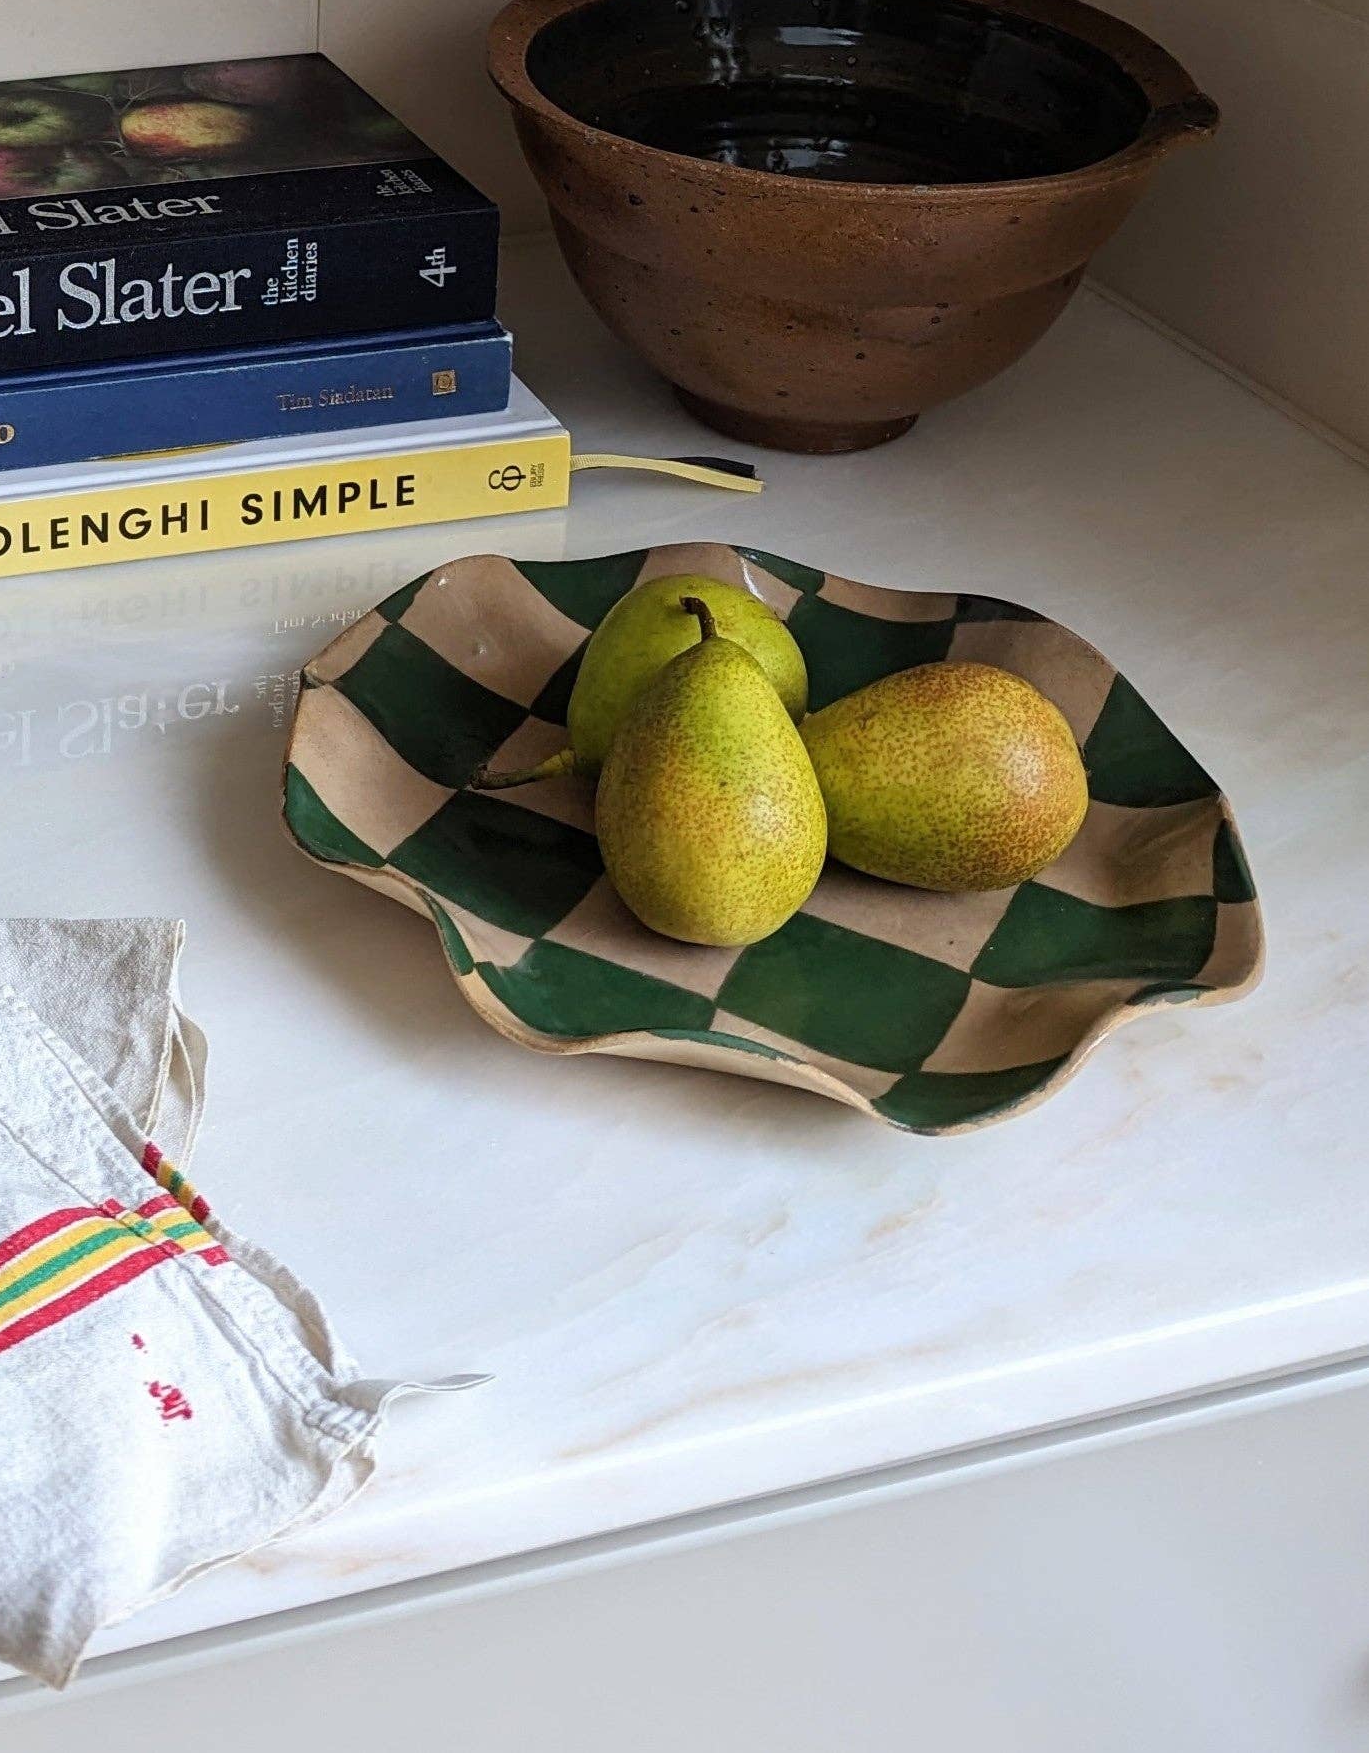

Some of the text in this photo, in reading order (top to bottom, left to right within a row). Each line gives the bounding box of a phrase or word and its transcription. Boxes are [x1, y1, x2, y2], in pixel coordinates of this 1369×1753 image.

[28, 195, 223, 231] Slater
[280, 238, 299, 304] kitchen
[299, 241, 318, 302] diaries
[419, 246, 457, 287] 4th
[57, 258, 251, 331] Slater
[261, 277, 279, 306] the
[277, 393, 313, 411] Tim
[318, 384, 395, 408] Siadatan
[240, 474, 416, 527] SIMPLE
